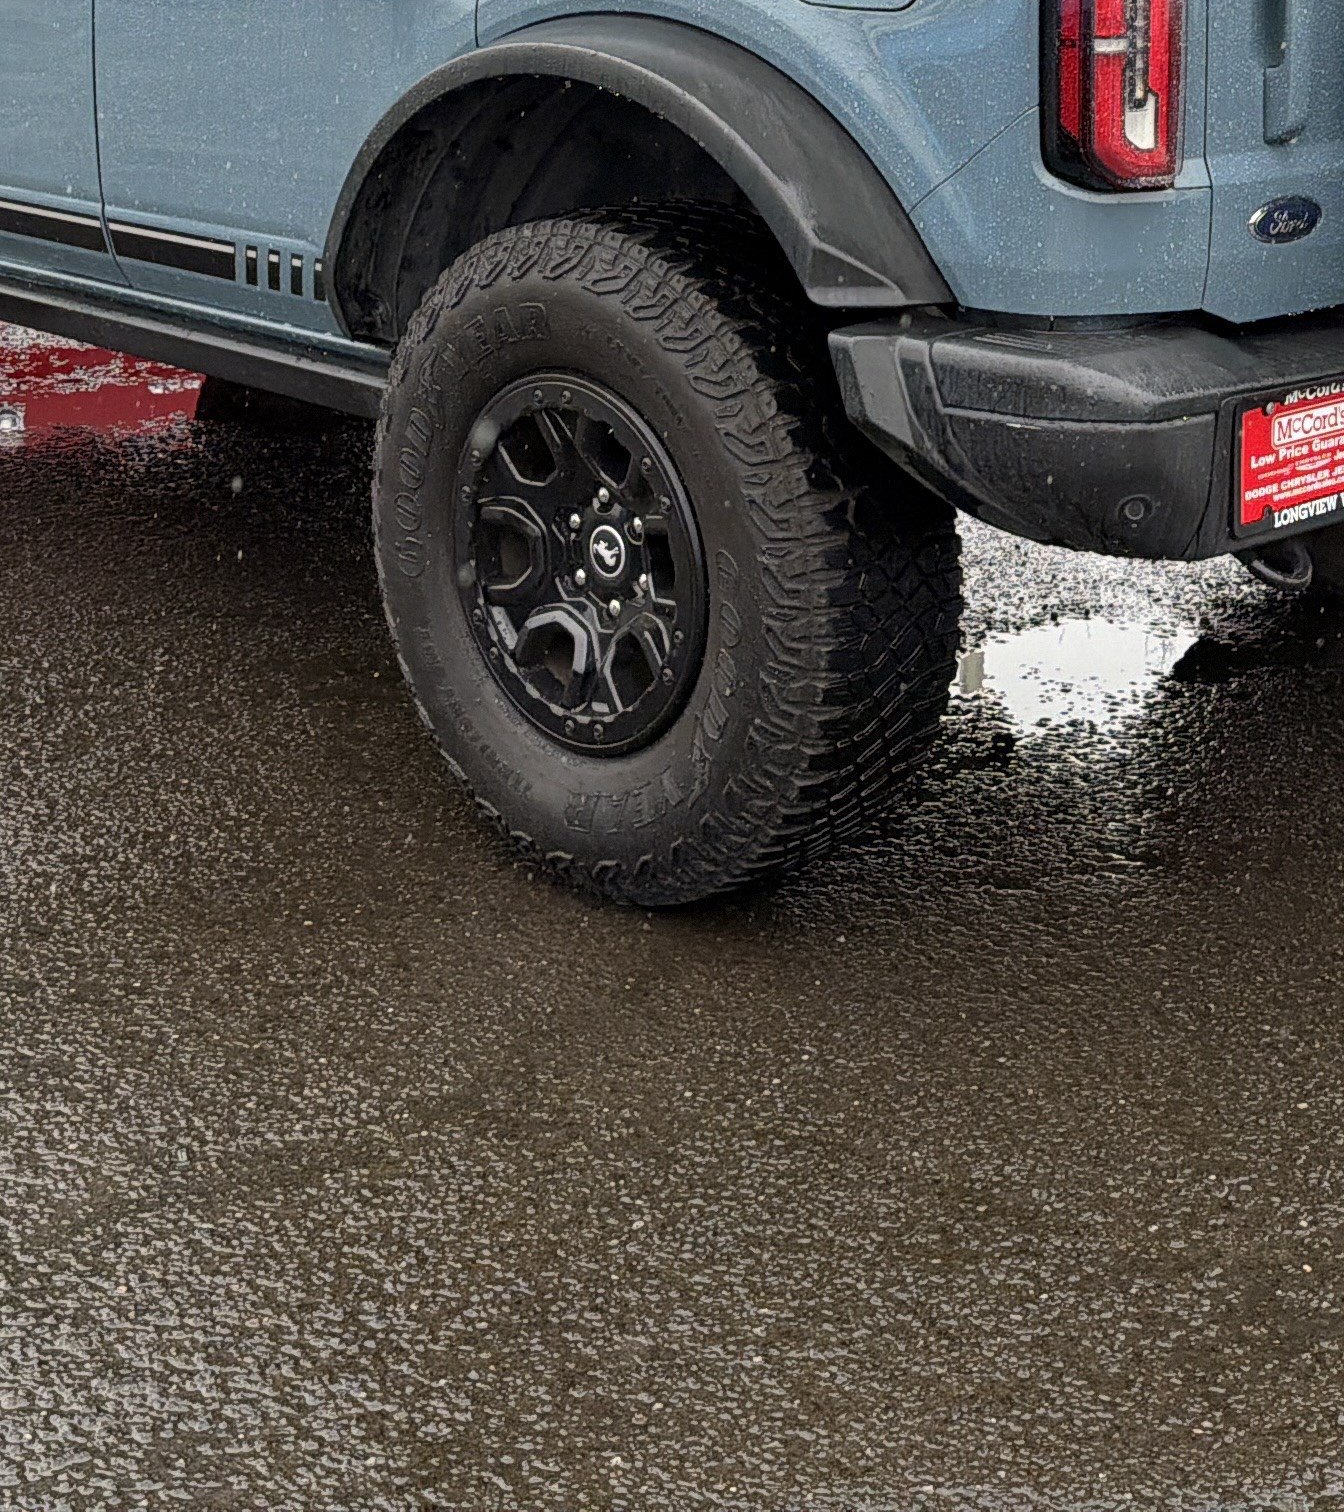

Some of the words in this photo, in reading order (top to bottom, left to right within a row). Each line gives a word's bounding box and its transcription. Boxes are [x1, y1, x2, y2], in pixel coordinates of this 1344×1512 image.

[1269, 209, 1309, 235] Ford
[392, 301, 552, 579] GOODYEAR
[1250, 451, 1276, 470] Low
[1278, 443, 1310, 461] Price
[1244, 484, 1279, 502] DODGE
[1280, 468, 1331, 492] CHRYSLER
[1273, 494, 1338, 528] LONGVIEW
[562, 547, 743, 834] GOODYEAR
